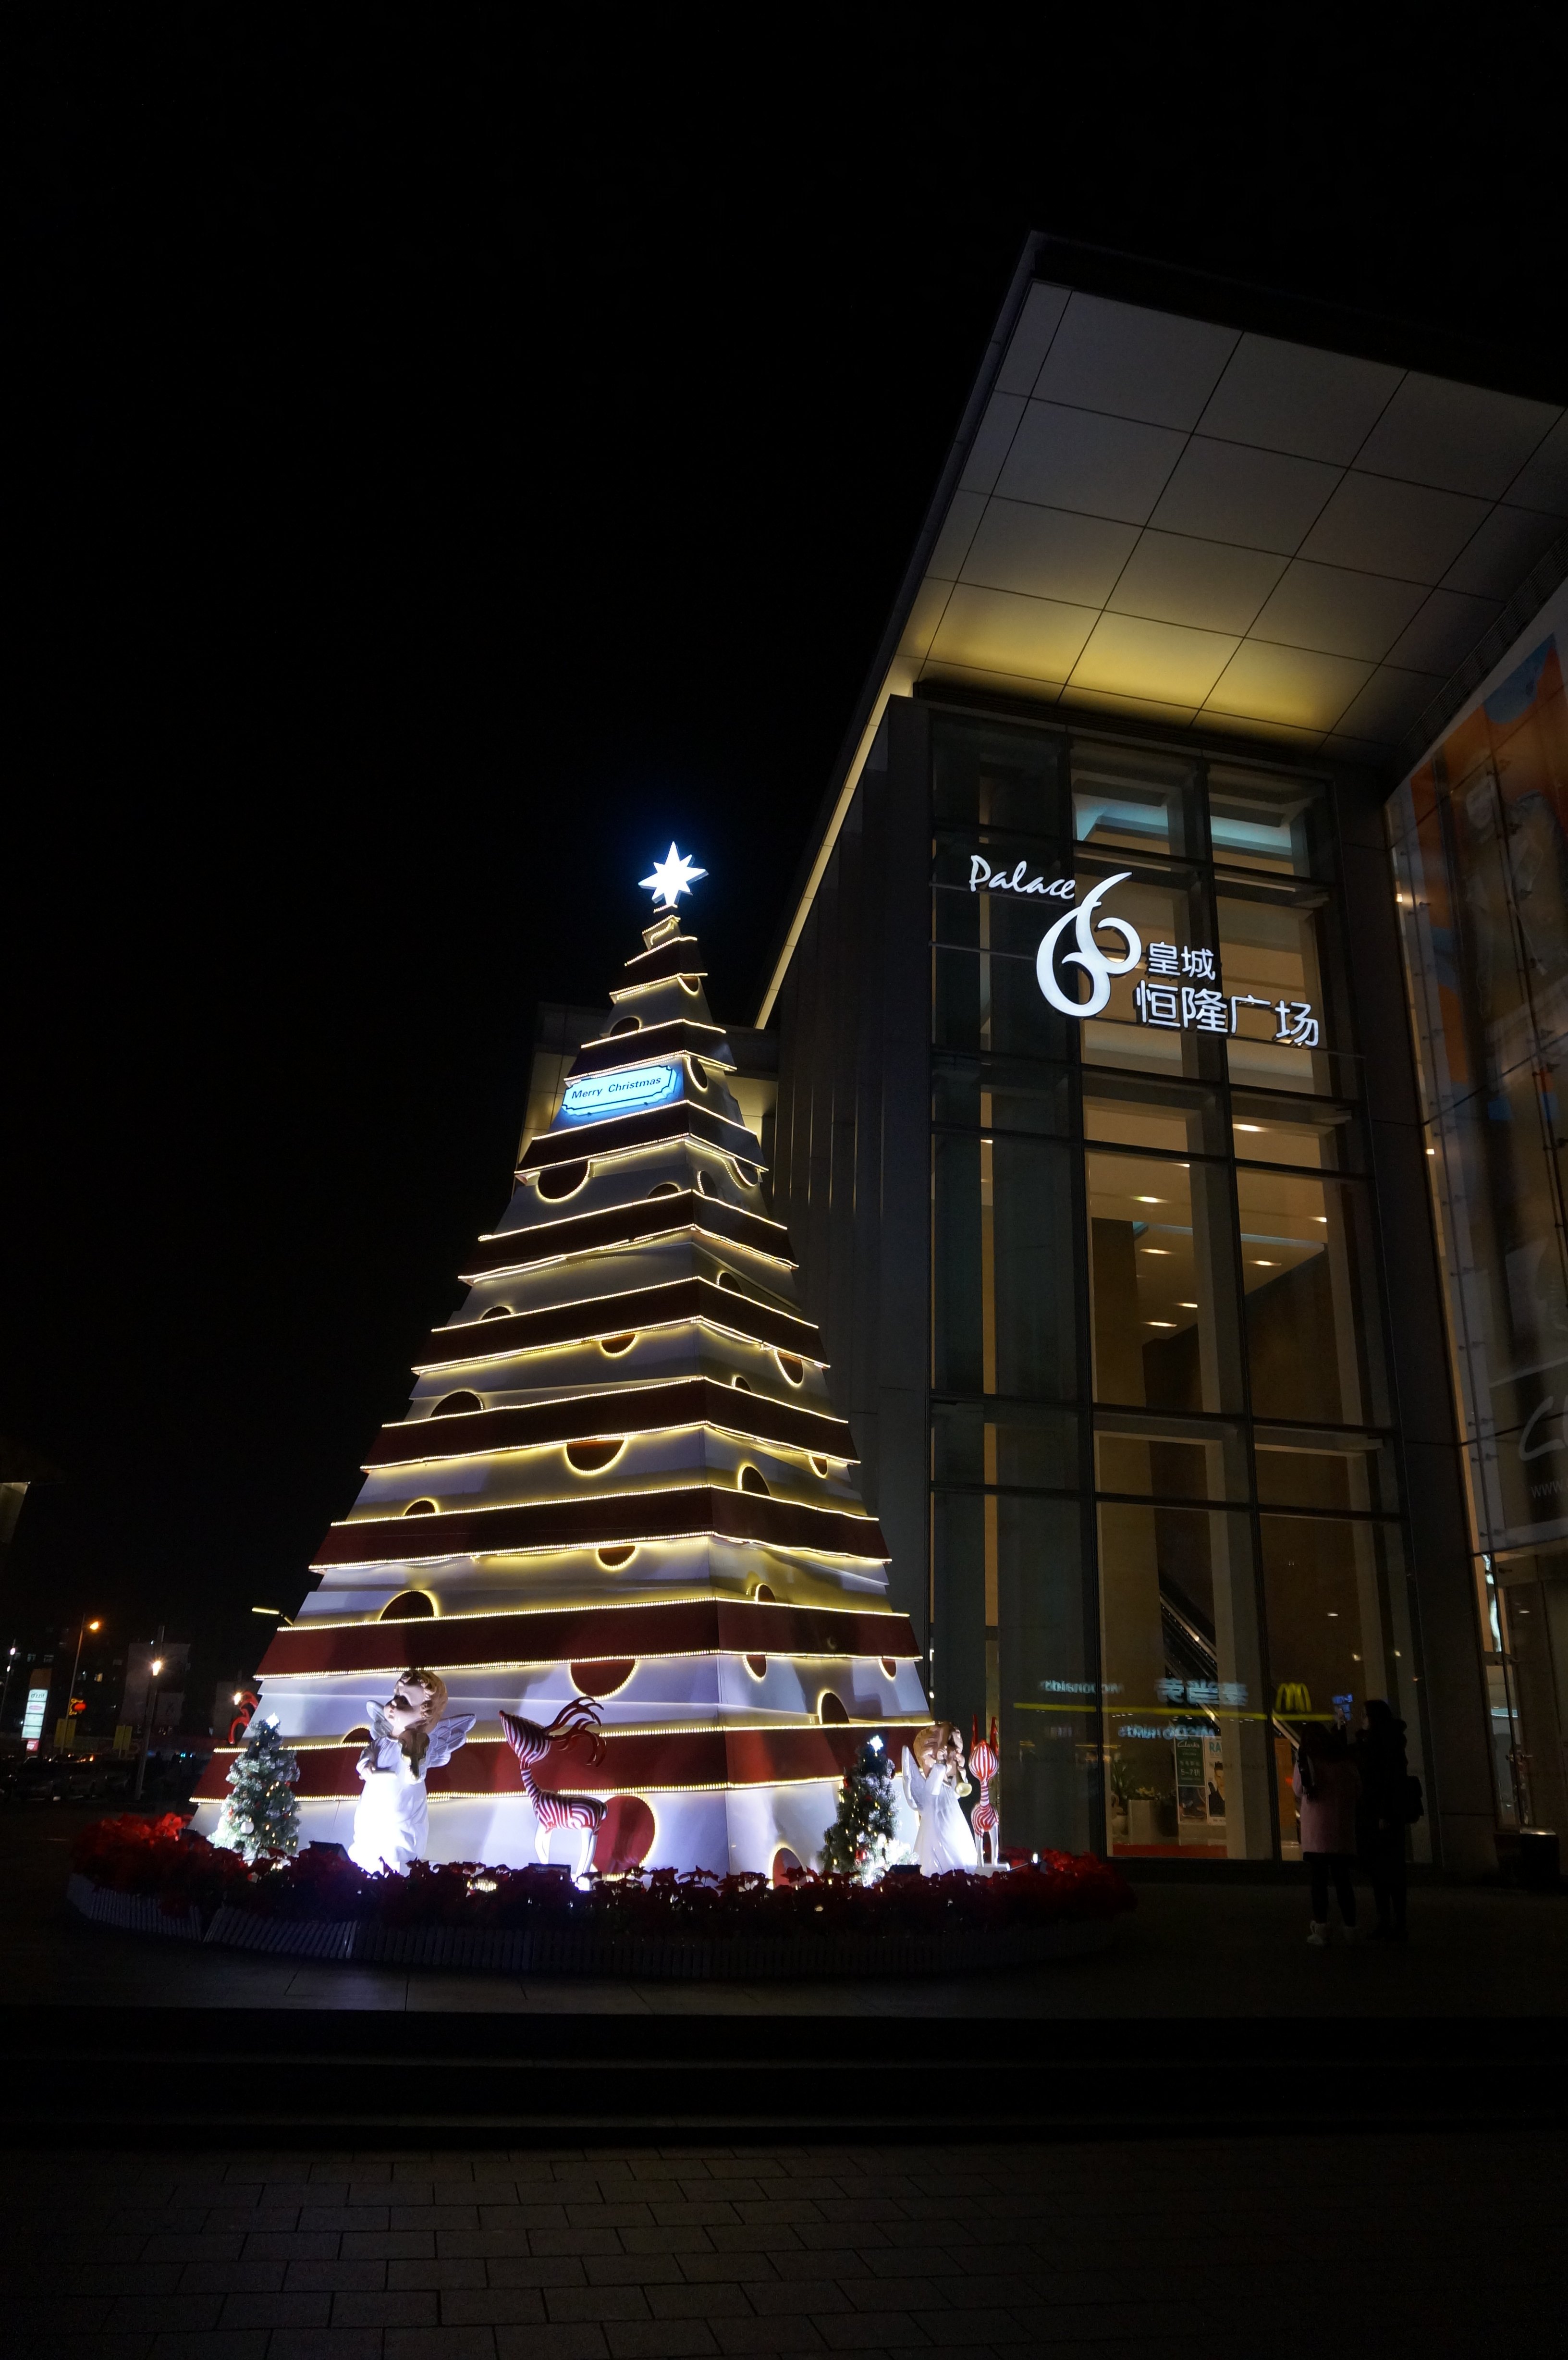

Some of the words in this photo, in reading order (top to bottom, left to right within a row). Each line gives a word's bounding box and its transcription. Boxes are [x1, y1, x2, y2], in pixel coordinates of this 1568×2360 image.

[969, 855, 1077, 899] Palace
[1147, 942, 1215, 981] 皇城
[1136, 980, 1319, 1046] 恒隆广场
[572, 1088, 602, 1099] Merry
[608, 1078, 661, 1092] Christmas
